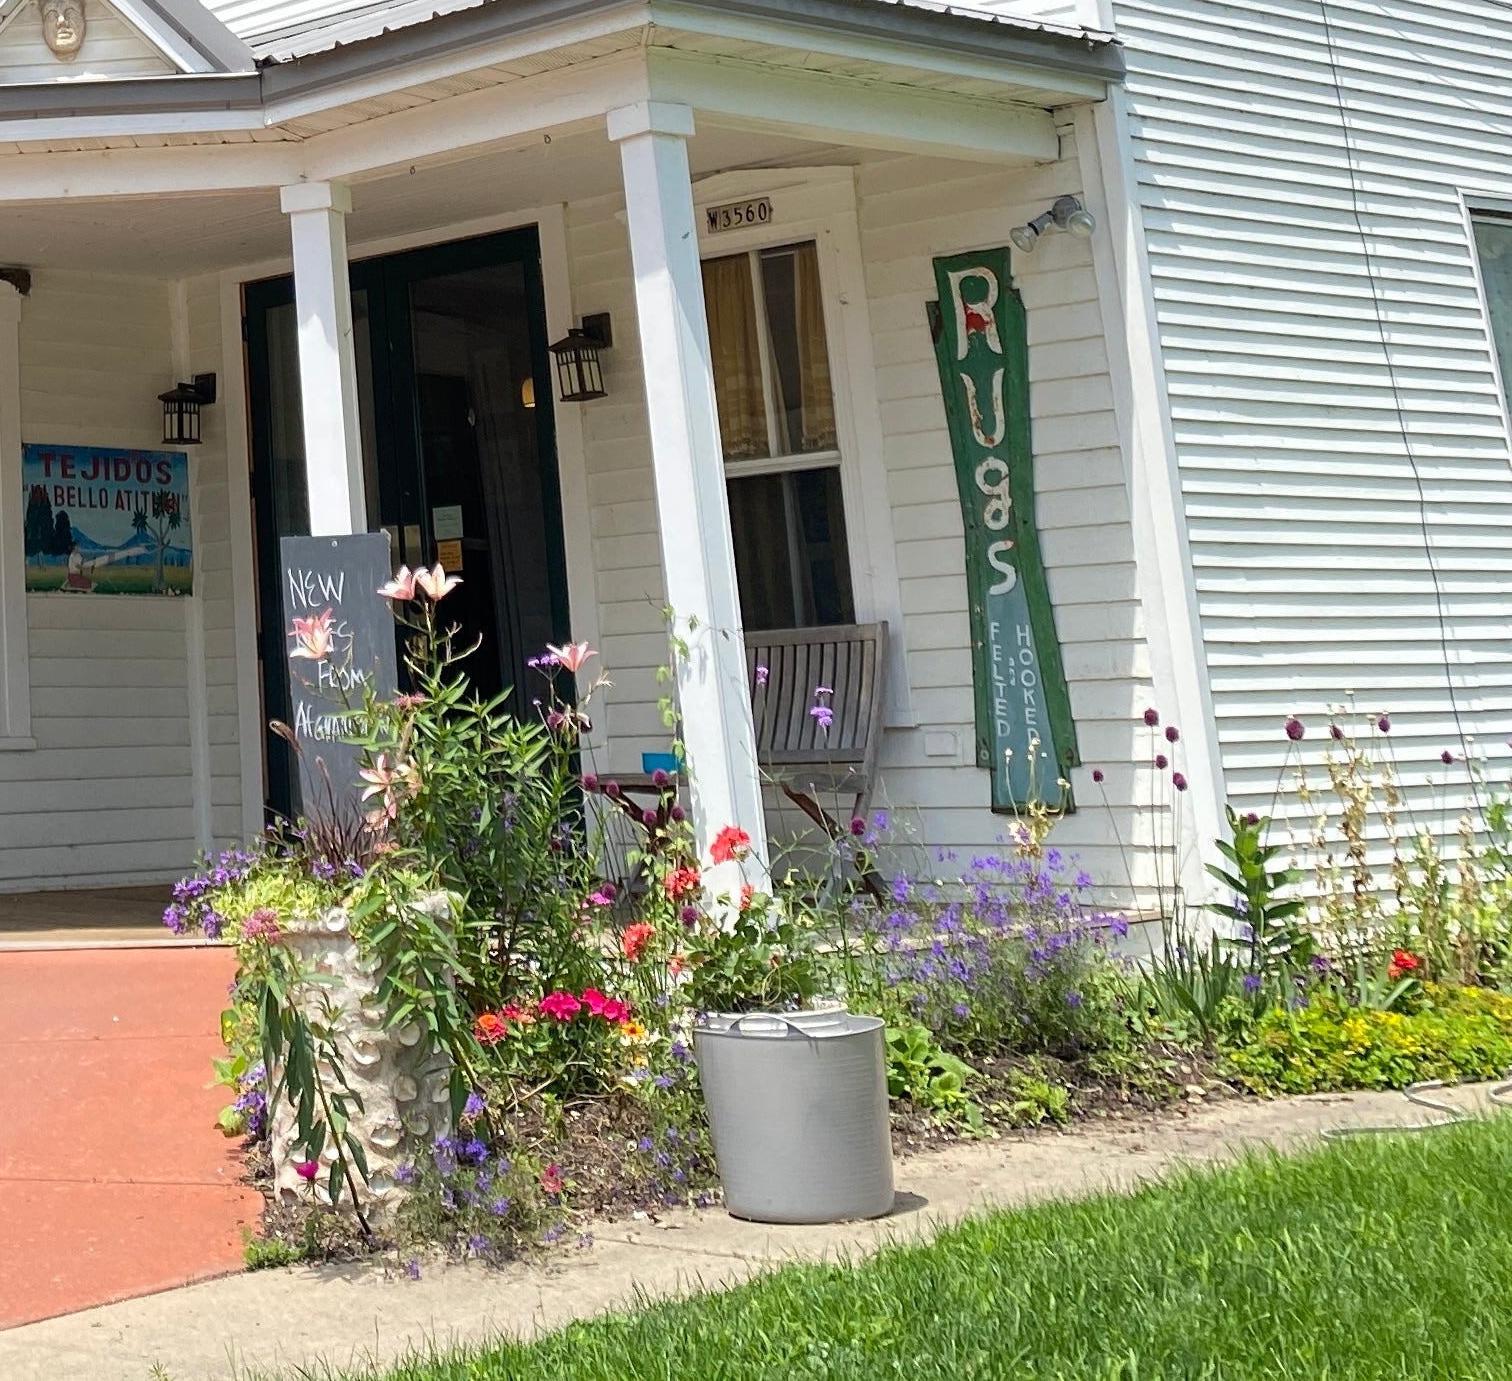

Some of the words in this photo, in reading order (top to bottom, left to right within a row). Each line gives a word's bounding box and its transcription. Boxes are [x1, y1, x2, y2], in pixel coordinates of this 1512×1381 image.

[707, 202, 767, 231] W3560
[38, 451, 173, 485] TEJIDOS
[54, 485, 109, 509] BELLO
[287, 567, 345, 608] NEW
[989, 621, 1011, 738] FELTED
[1016, 623, 1041, 746] HOOKED
